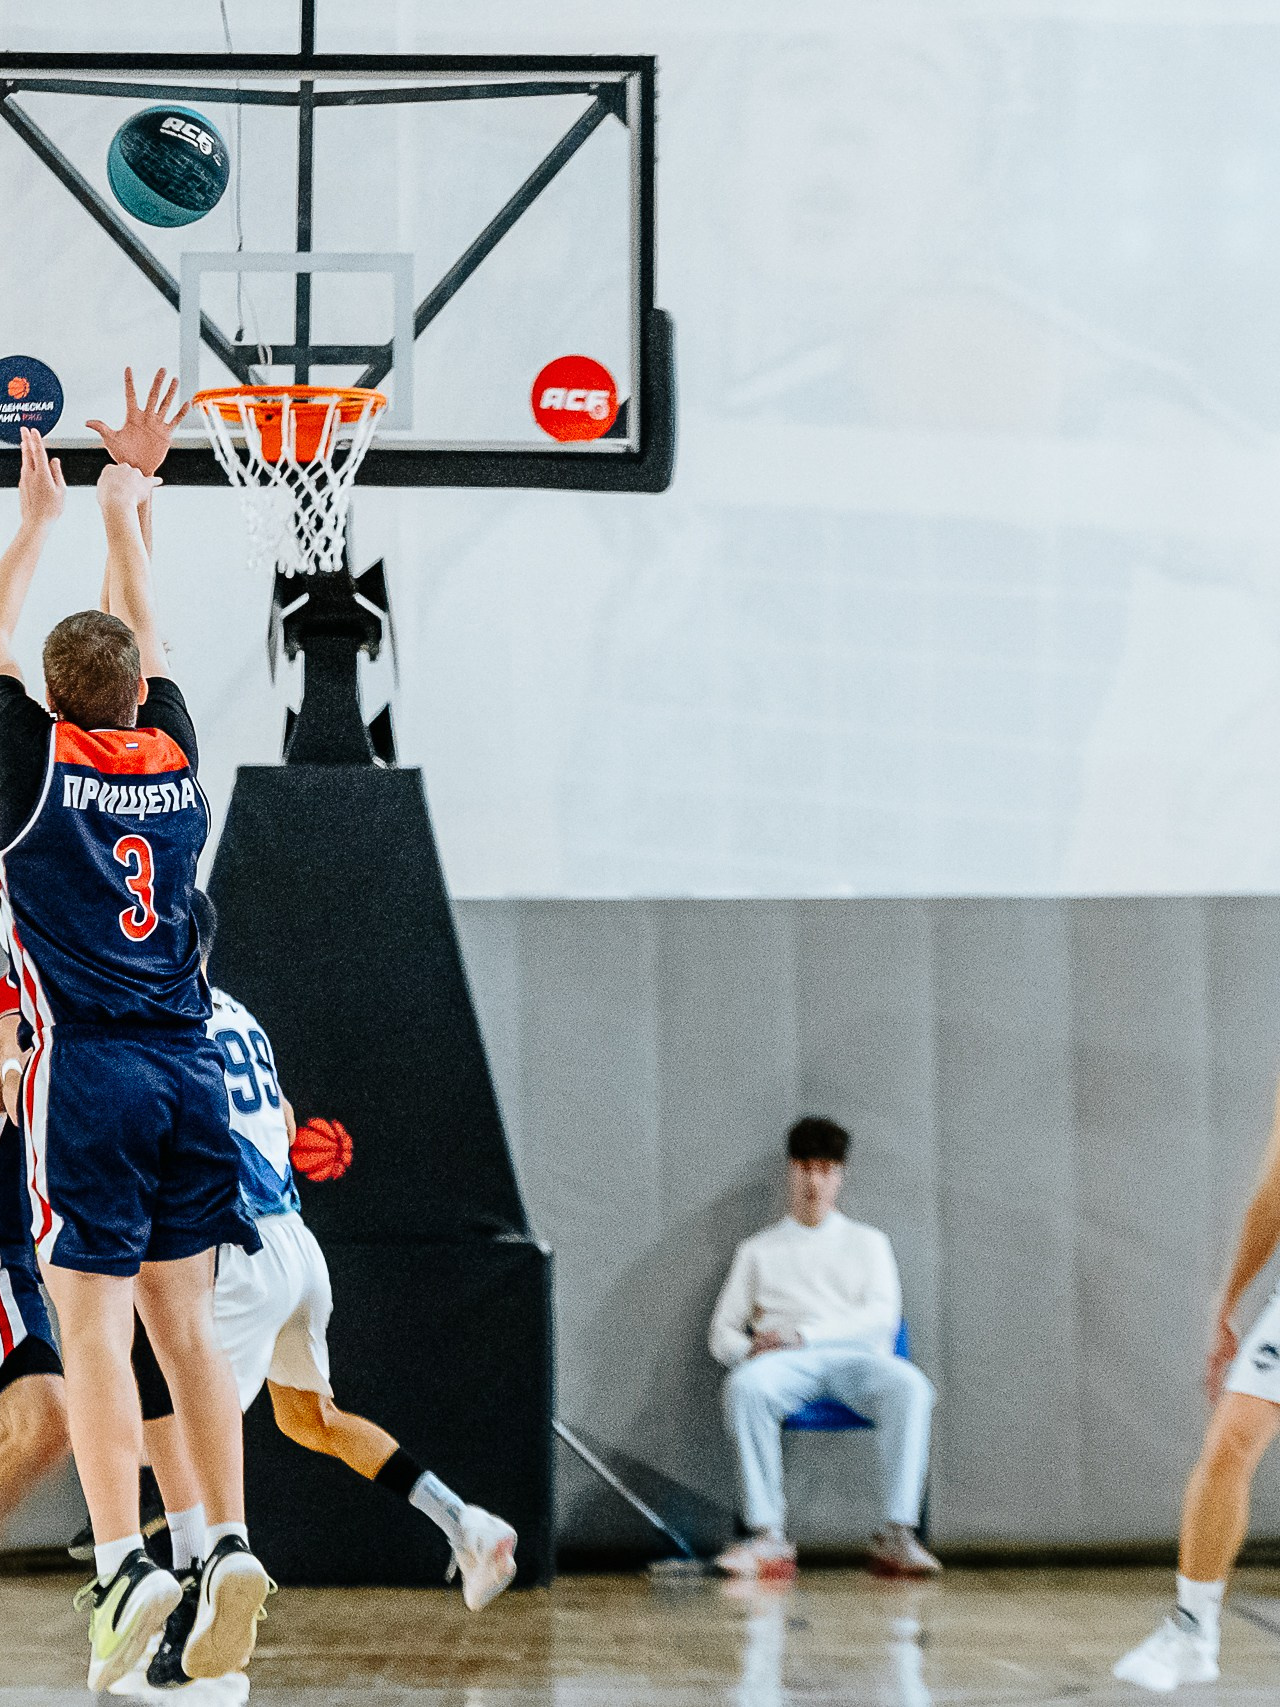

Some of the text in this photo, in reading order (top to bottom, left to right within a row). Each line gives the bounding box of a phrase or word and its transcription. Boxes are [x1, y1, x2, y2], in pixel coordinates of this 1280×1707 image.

[160, 116, 215, 156] АСБ
[540, 387, 610, 420] АСБ
[62, 774, 197, 821] ПРИЩЕПА
[113, 833, 159, 942] 3
[213, 1028, 281, 1114] 99
